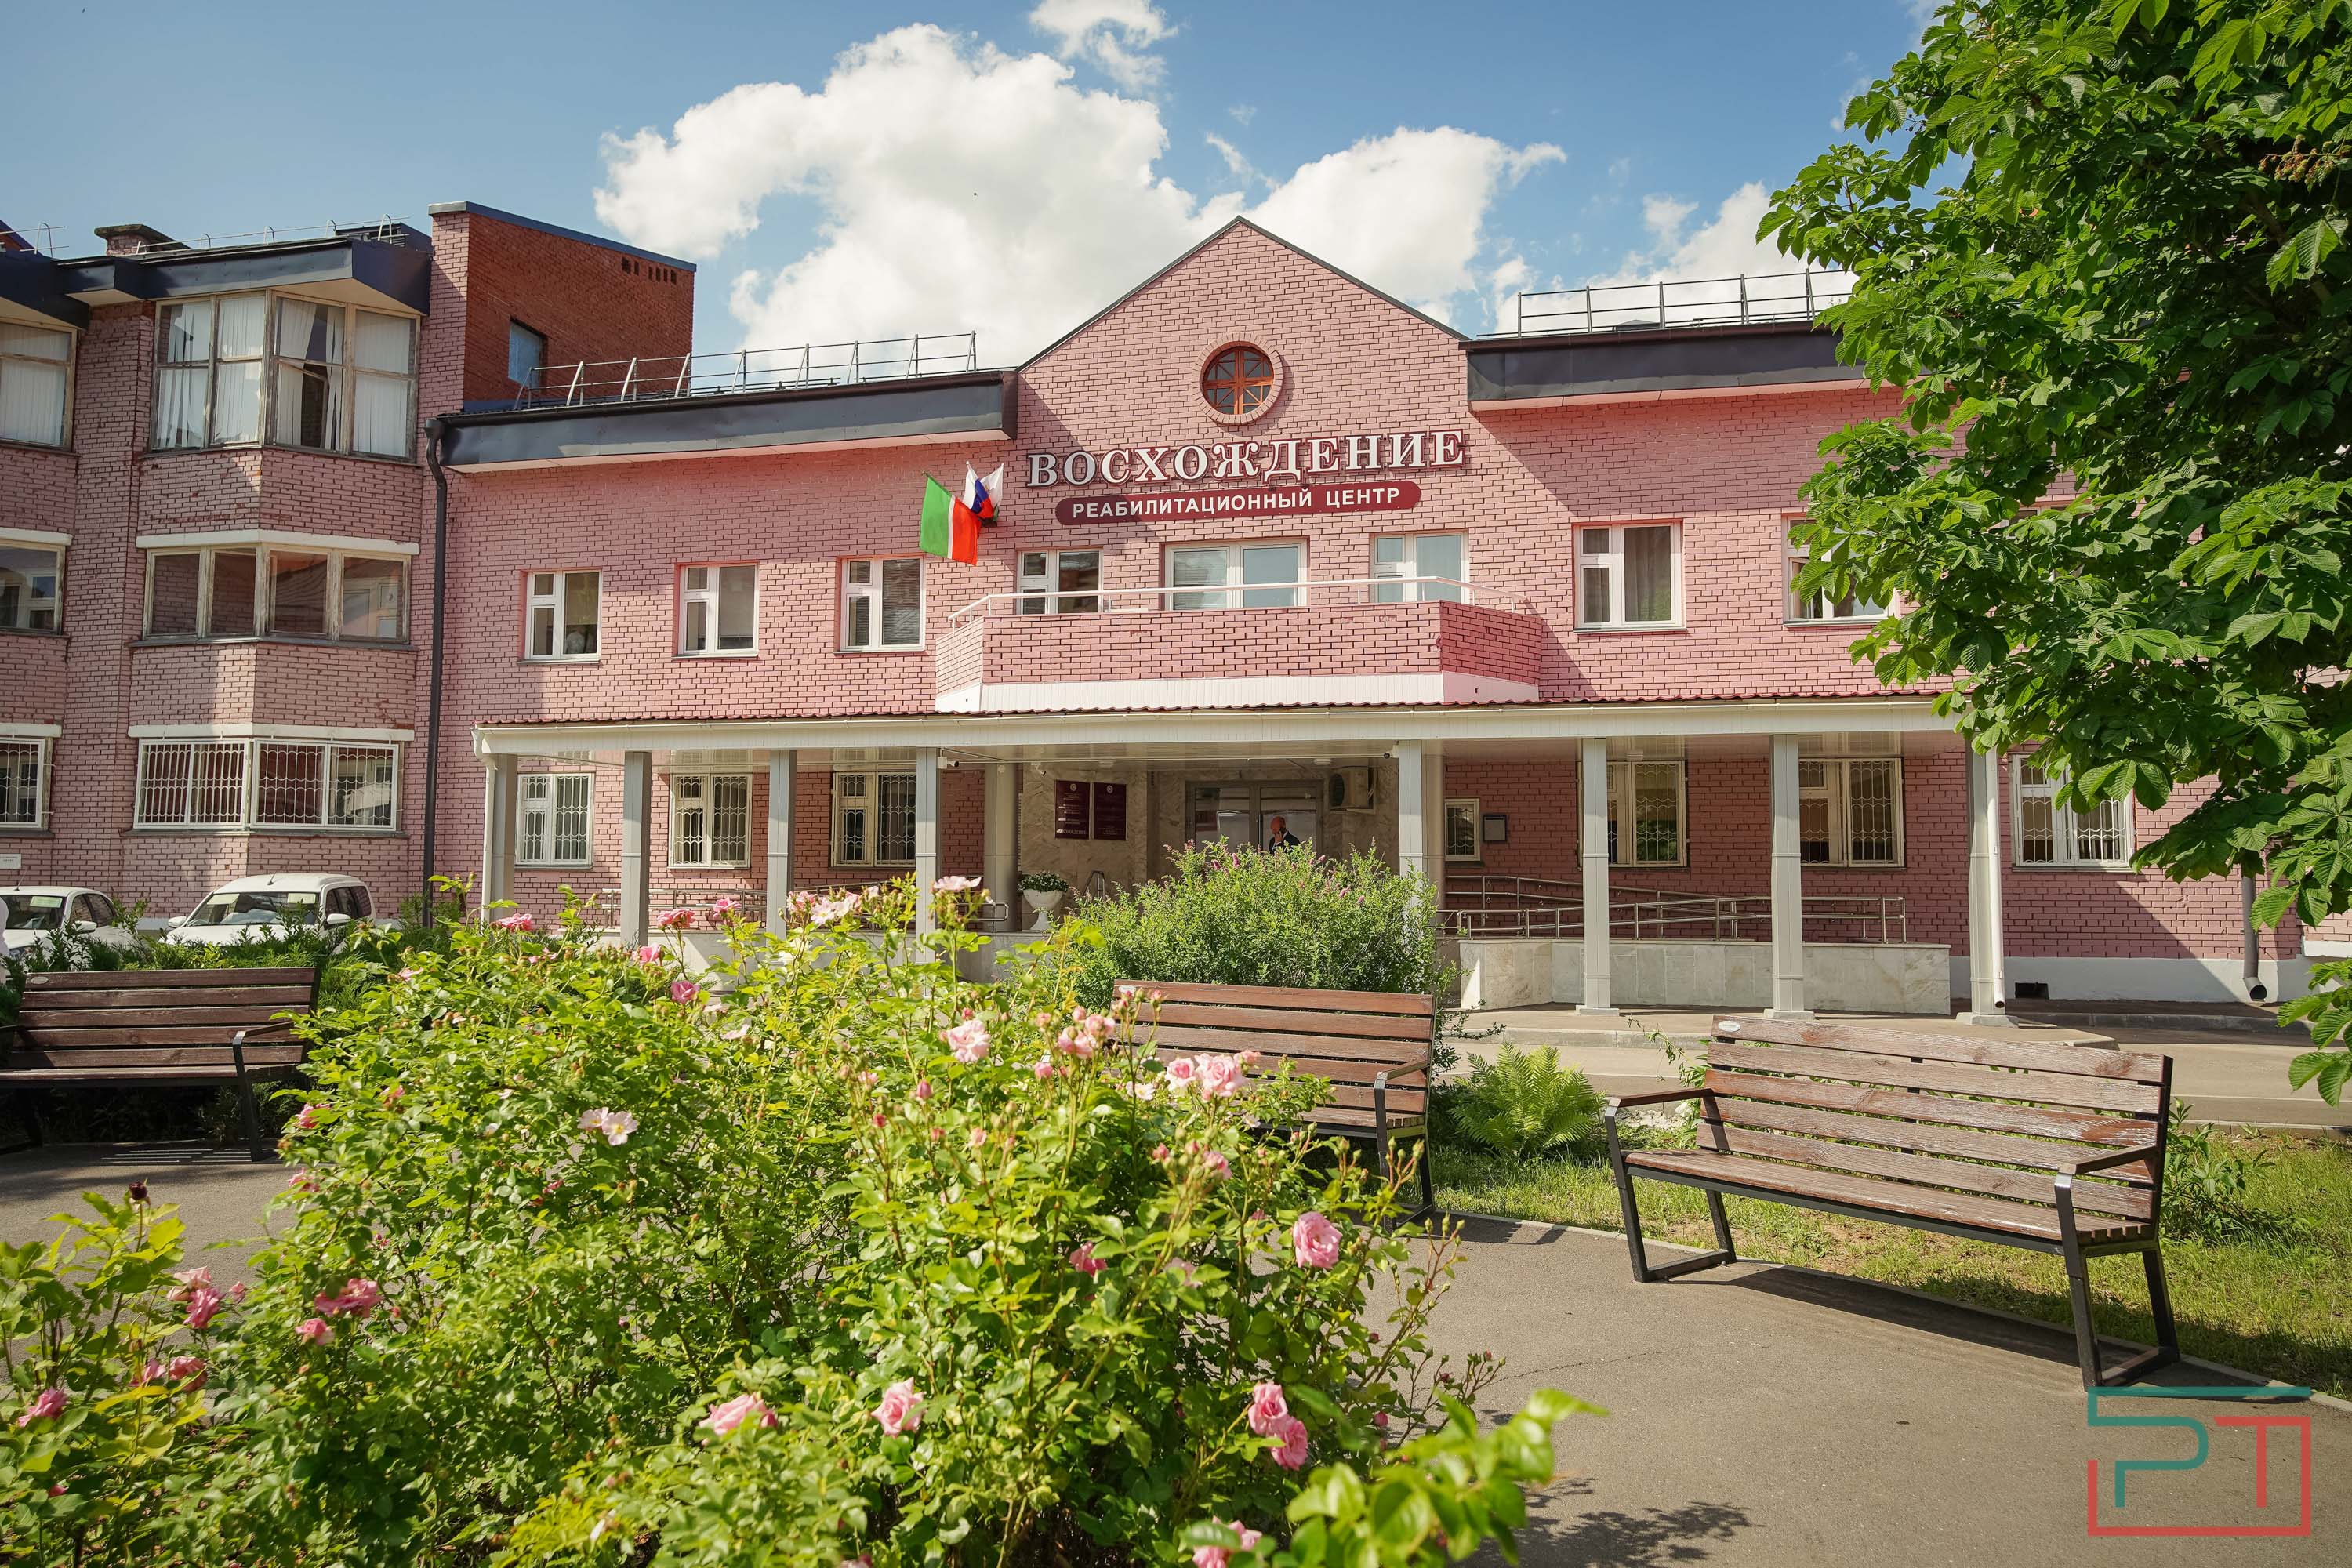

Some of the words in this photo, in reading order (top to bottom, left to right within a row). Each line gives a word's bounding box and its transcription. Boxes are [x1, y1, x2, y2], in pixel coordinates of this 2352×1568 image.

[1026, 430, 1465, 485] ВОСХОЖДЕНИЕ
[1073, 488, 1312, 518] РЕАБИЛИТАЦИОННЫЙ
[1325, 488, 1400, 509] ЦЕНТР
